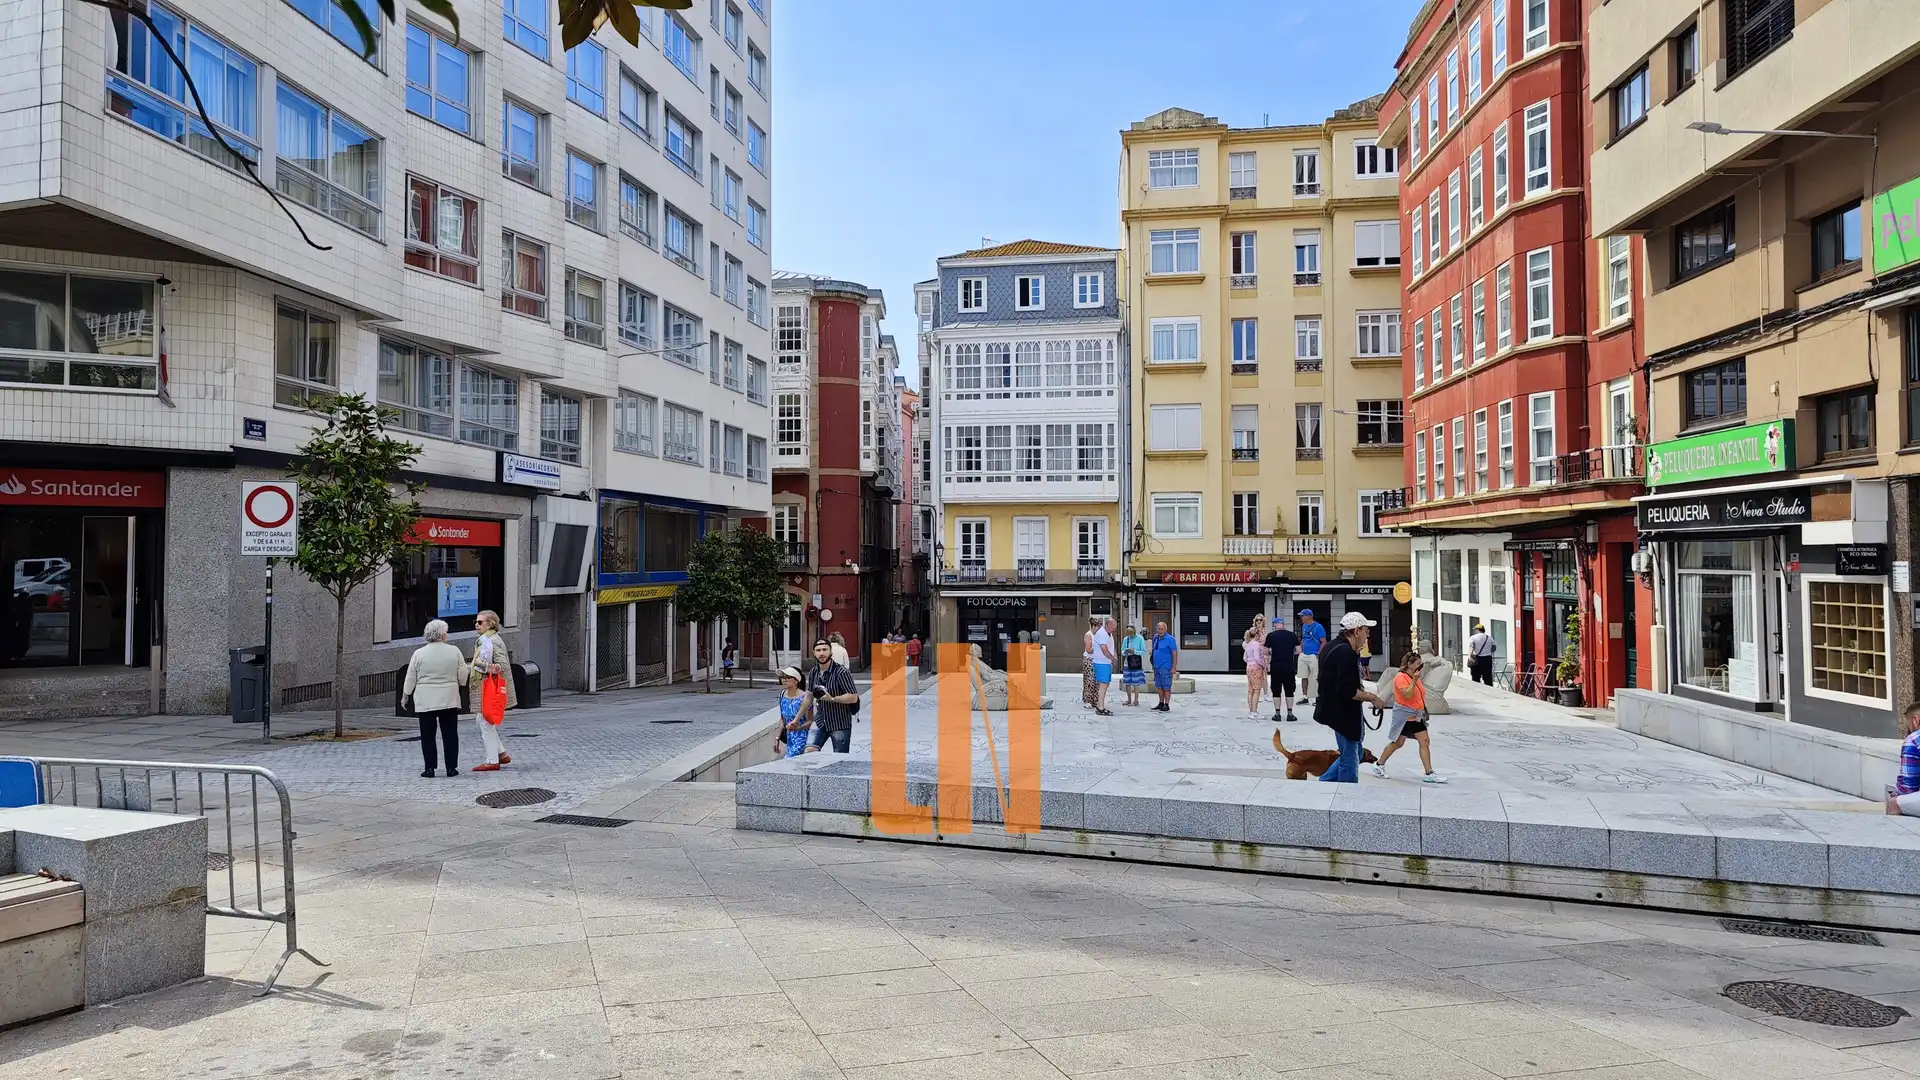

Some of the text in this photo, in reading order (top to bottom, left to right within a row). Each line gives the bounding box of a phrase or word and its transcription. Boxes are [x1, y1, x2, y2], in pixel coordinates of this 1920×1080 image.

[1663, 437, 1761, 475] PELUQUERIA INFANTIL
[30, 479, 142, 497] Santander
[1647, 501, 1711, 523] PELUQUERÍA
[1766, 495, 1806, 517] Studio
[437, 525, 470, 539] Santander
[1179, 573, 1241, 582] BAR RIO AVIA
[966, 597, 1027, 606] FOTOCOPIAS
